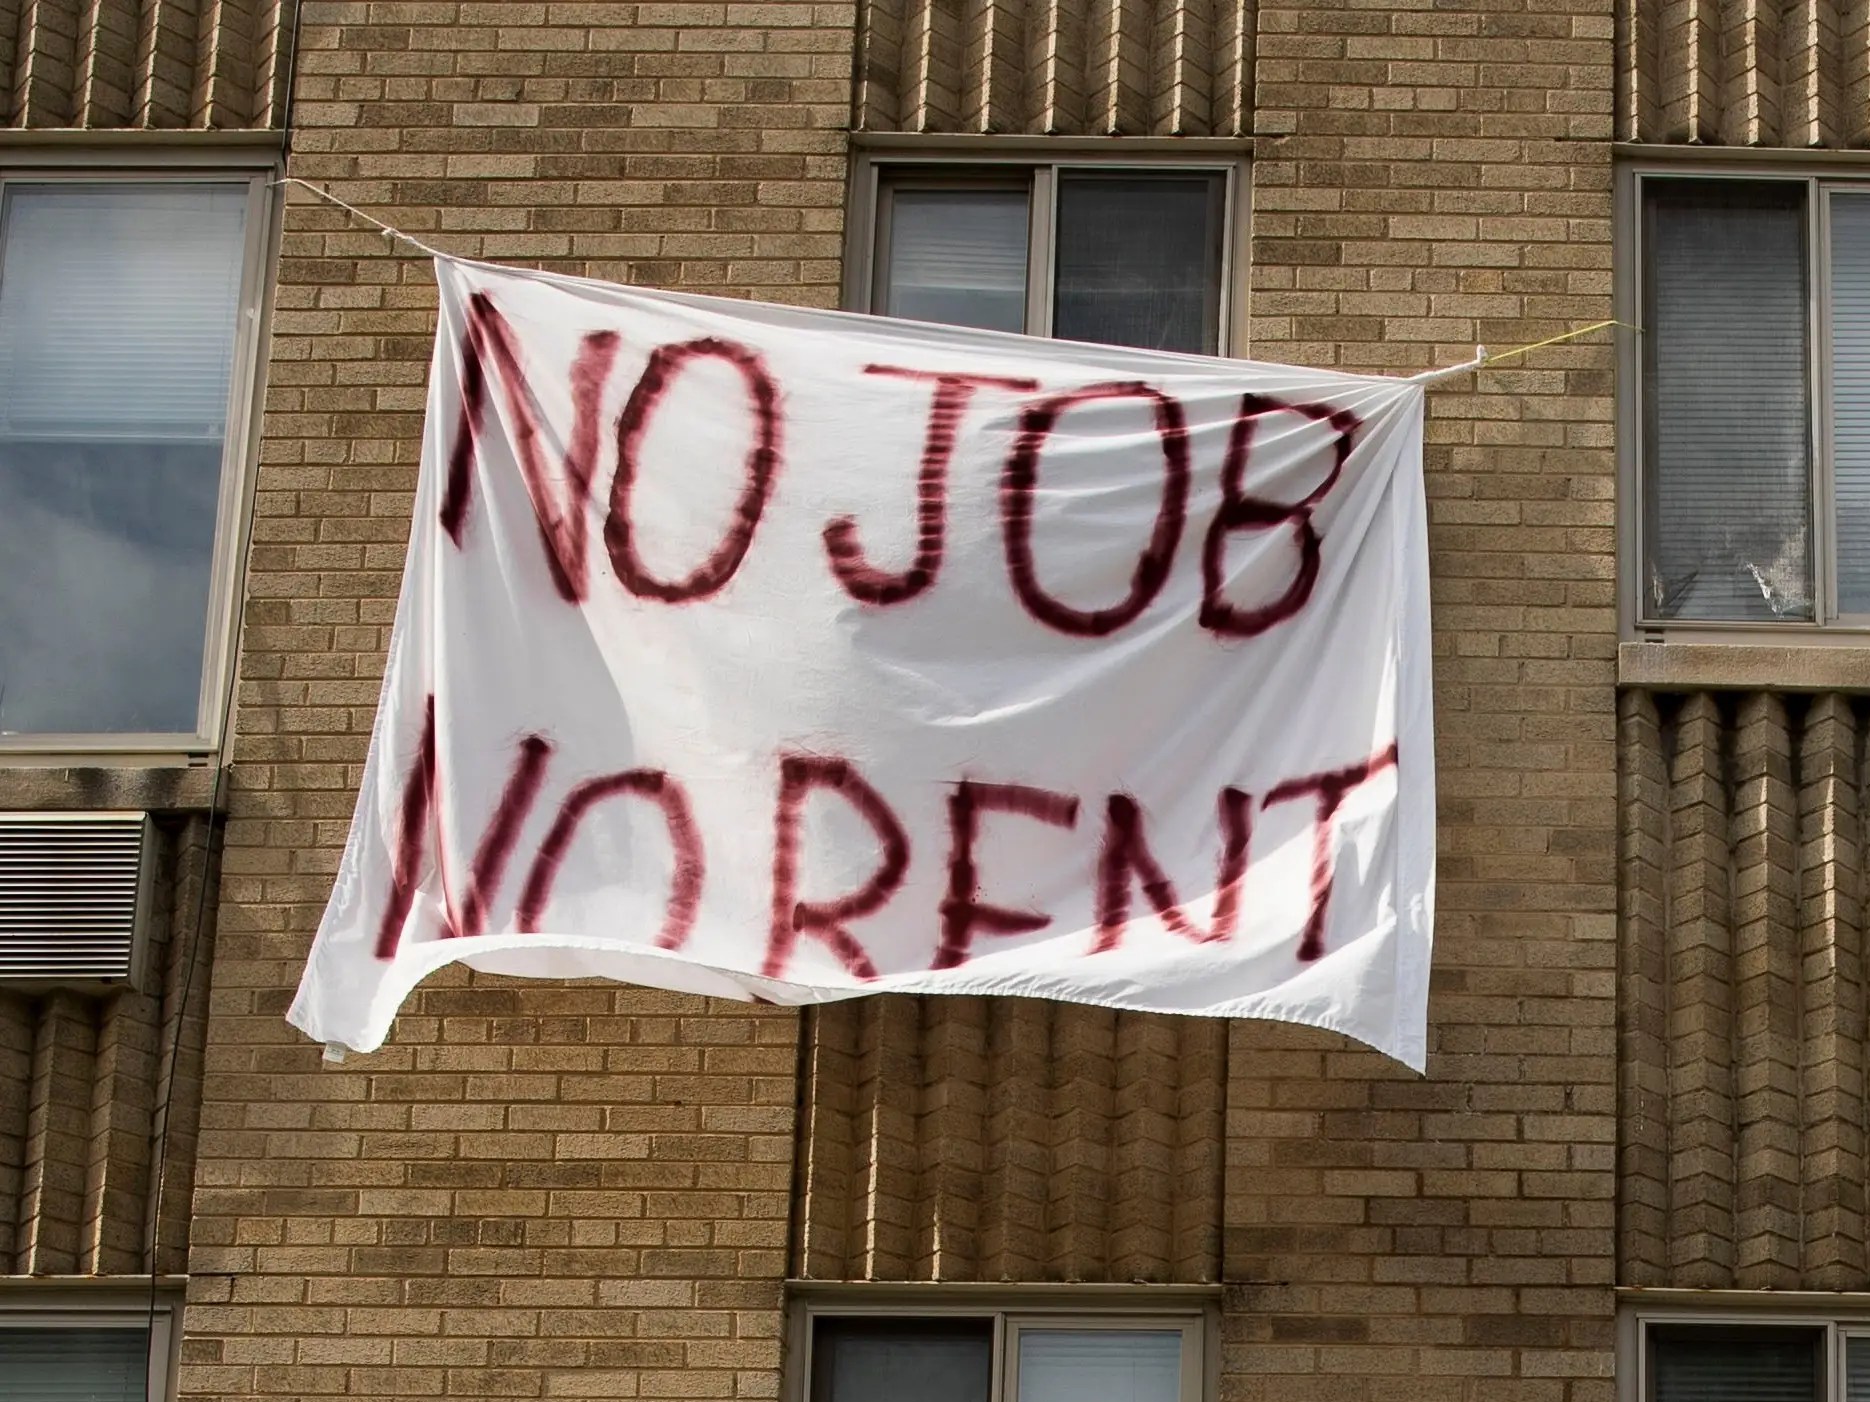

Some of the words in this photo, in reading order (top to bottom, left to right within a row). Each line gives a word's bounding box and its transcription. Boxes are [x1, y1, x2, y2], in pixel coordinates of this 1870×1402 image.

[442, 292, 785, 603] NO
[824, 363, 1361, 637] JOB
[761, 744, 1398, 981] RENT
